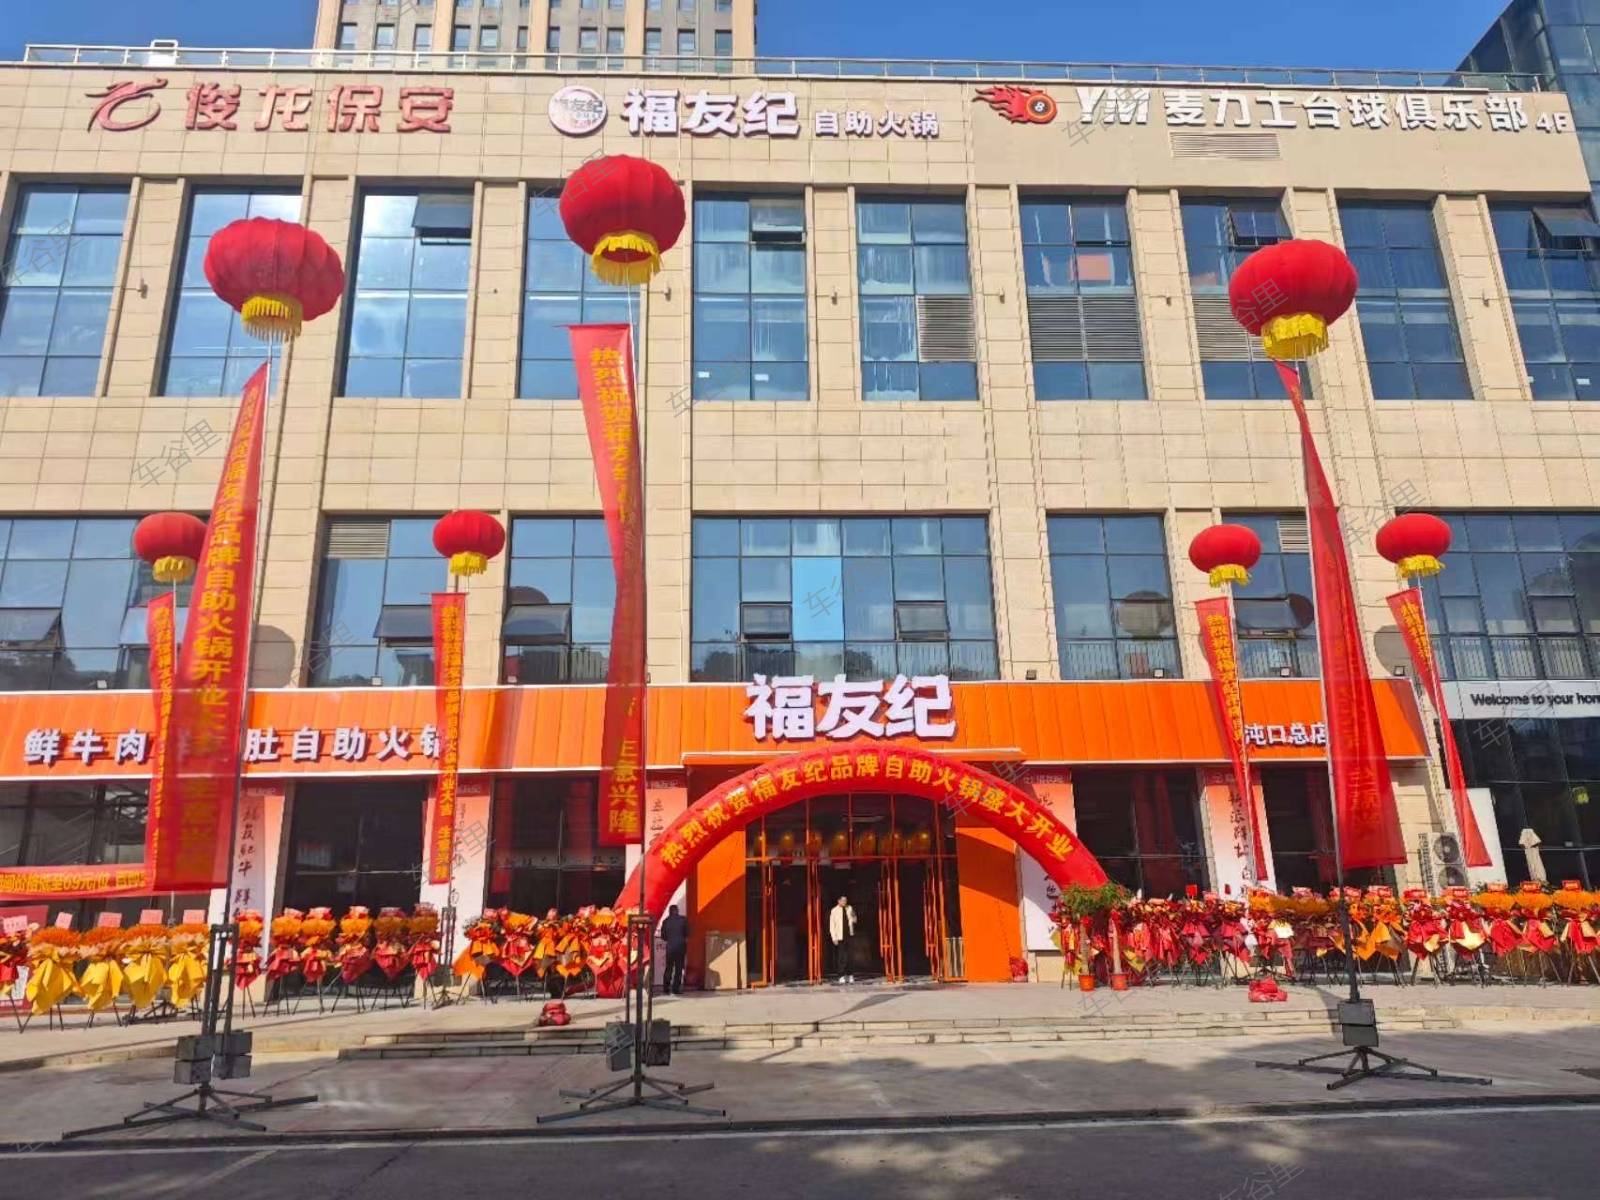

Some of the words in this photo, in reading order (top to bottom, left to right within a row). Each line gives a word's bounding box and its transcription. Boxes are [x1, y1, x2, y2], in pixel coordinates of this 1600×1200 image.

[185, 82, 454, 132] 俊龙保安
[621, 89, 800, 137] 福友纪
[815, 111, 940, 137] 自助火锅
[1164, 90, 1528, 132] 麦力士台球俱乐部
[745, 673, 956, 740] 福友纪
[1470, 693, 1530, 706] Welcome
[1531, 693, 1545, 705] to
[1547, 695, 1574, 708] your
[1244, 722, 1328, 746] 沌口总店
[660, 755, 1075, 869] 热烈祝贺福友纪品牌自助火锅盛大开业
